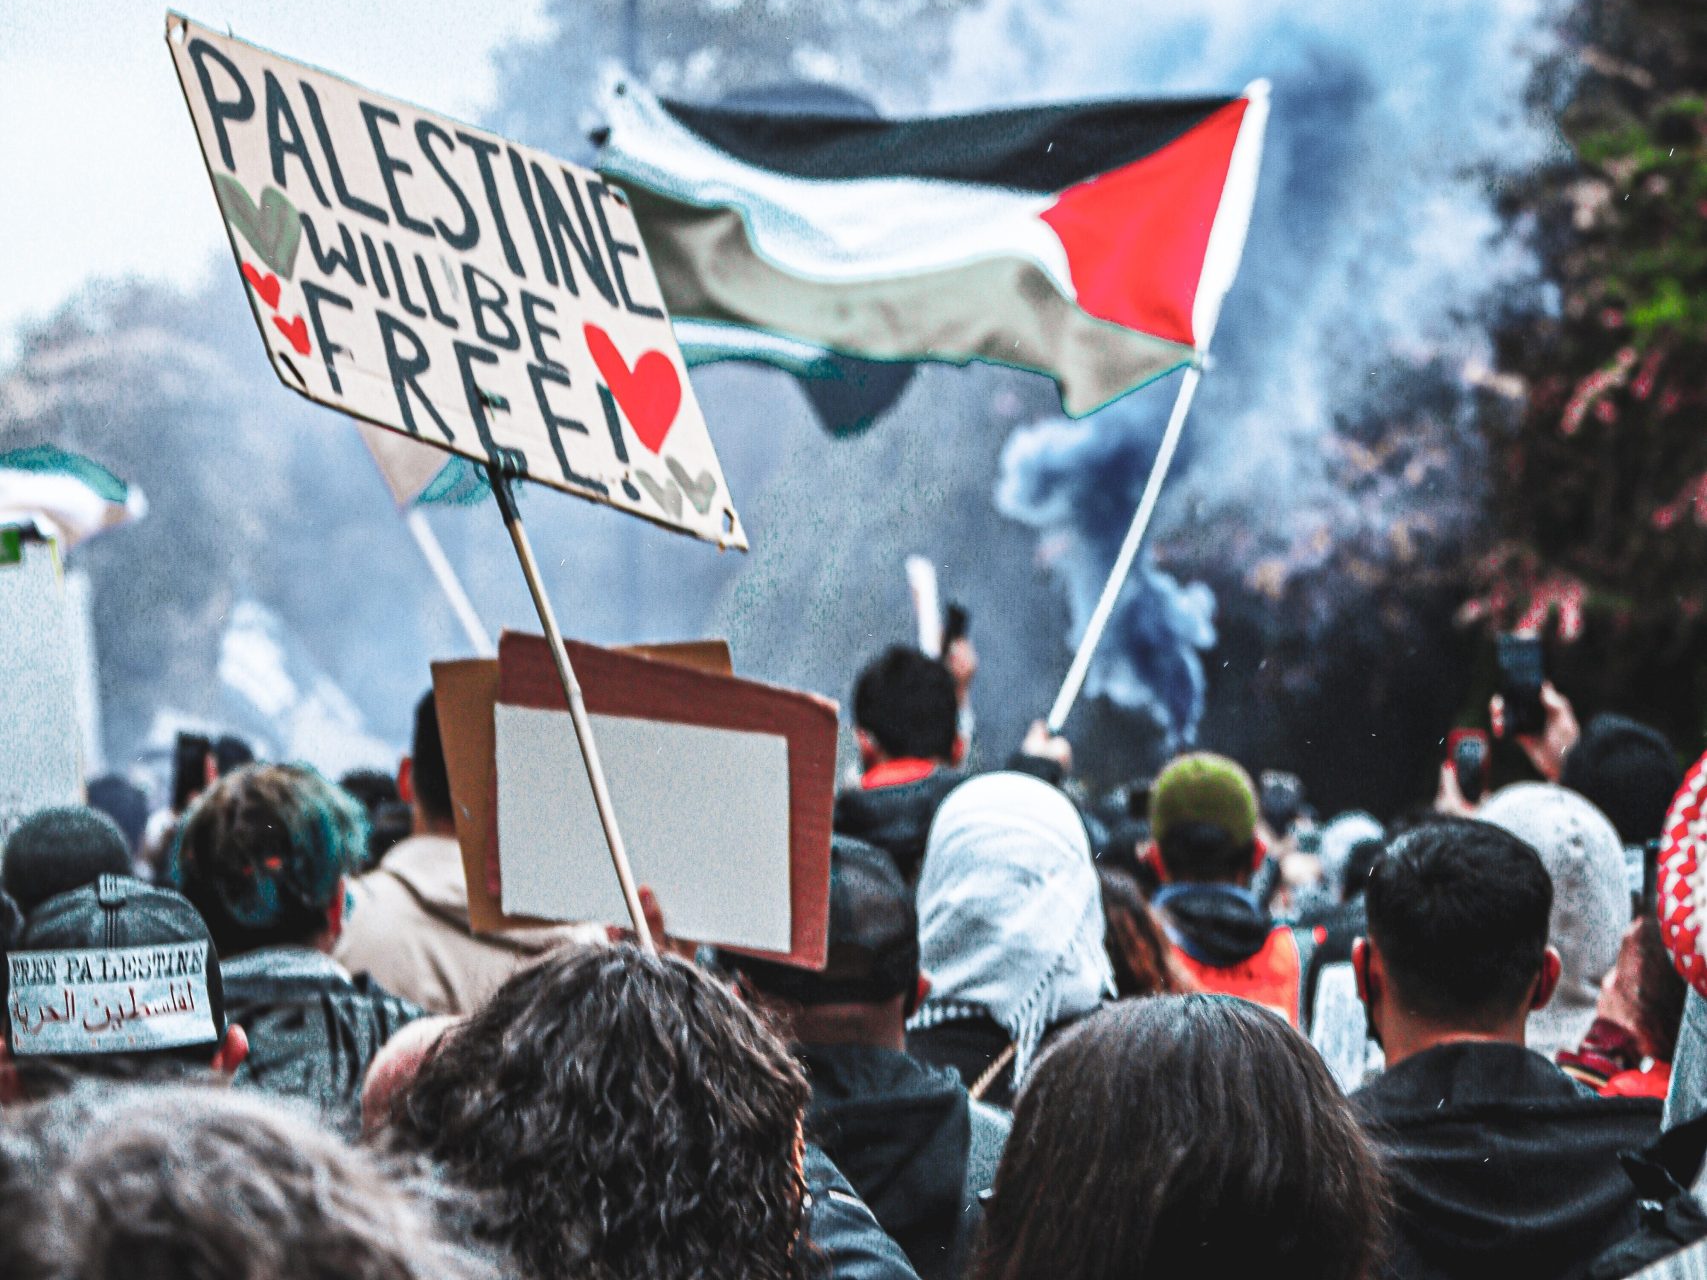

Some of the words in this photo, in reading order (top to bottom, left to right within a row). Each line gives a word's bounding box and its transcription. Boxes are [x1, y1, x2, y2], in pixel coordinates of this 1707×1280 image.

[188, 38, 665, 321] PALESTINE
[300, 212, 459, 330] WILL
[462, 262, 570, 376] BE
[301, 280, 641, 502] FREE!
[11, 957, 57, 987] FREE
[64, 947, 204, 984] PALESTINE
